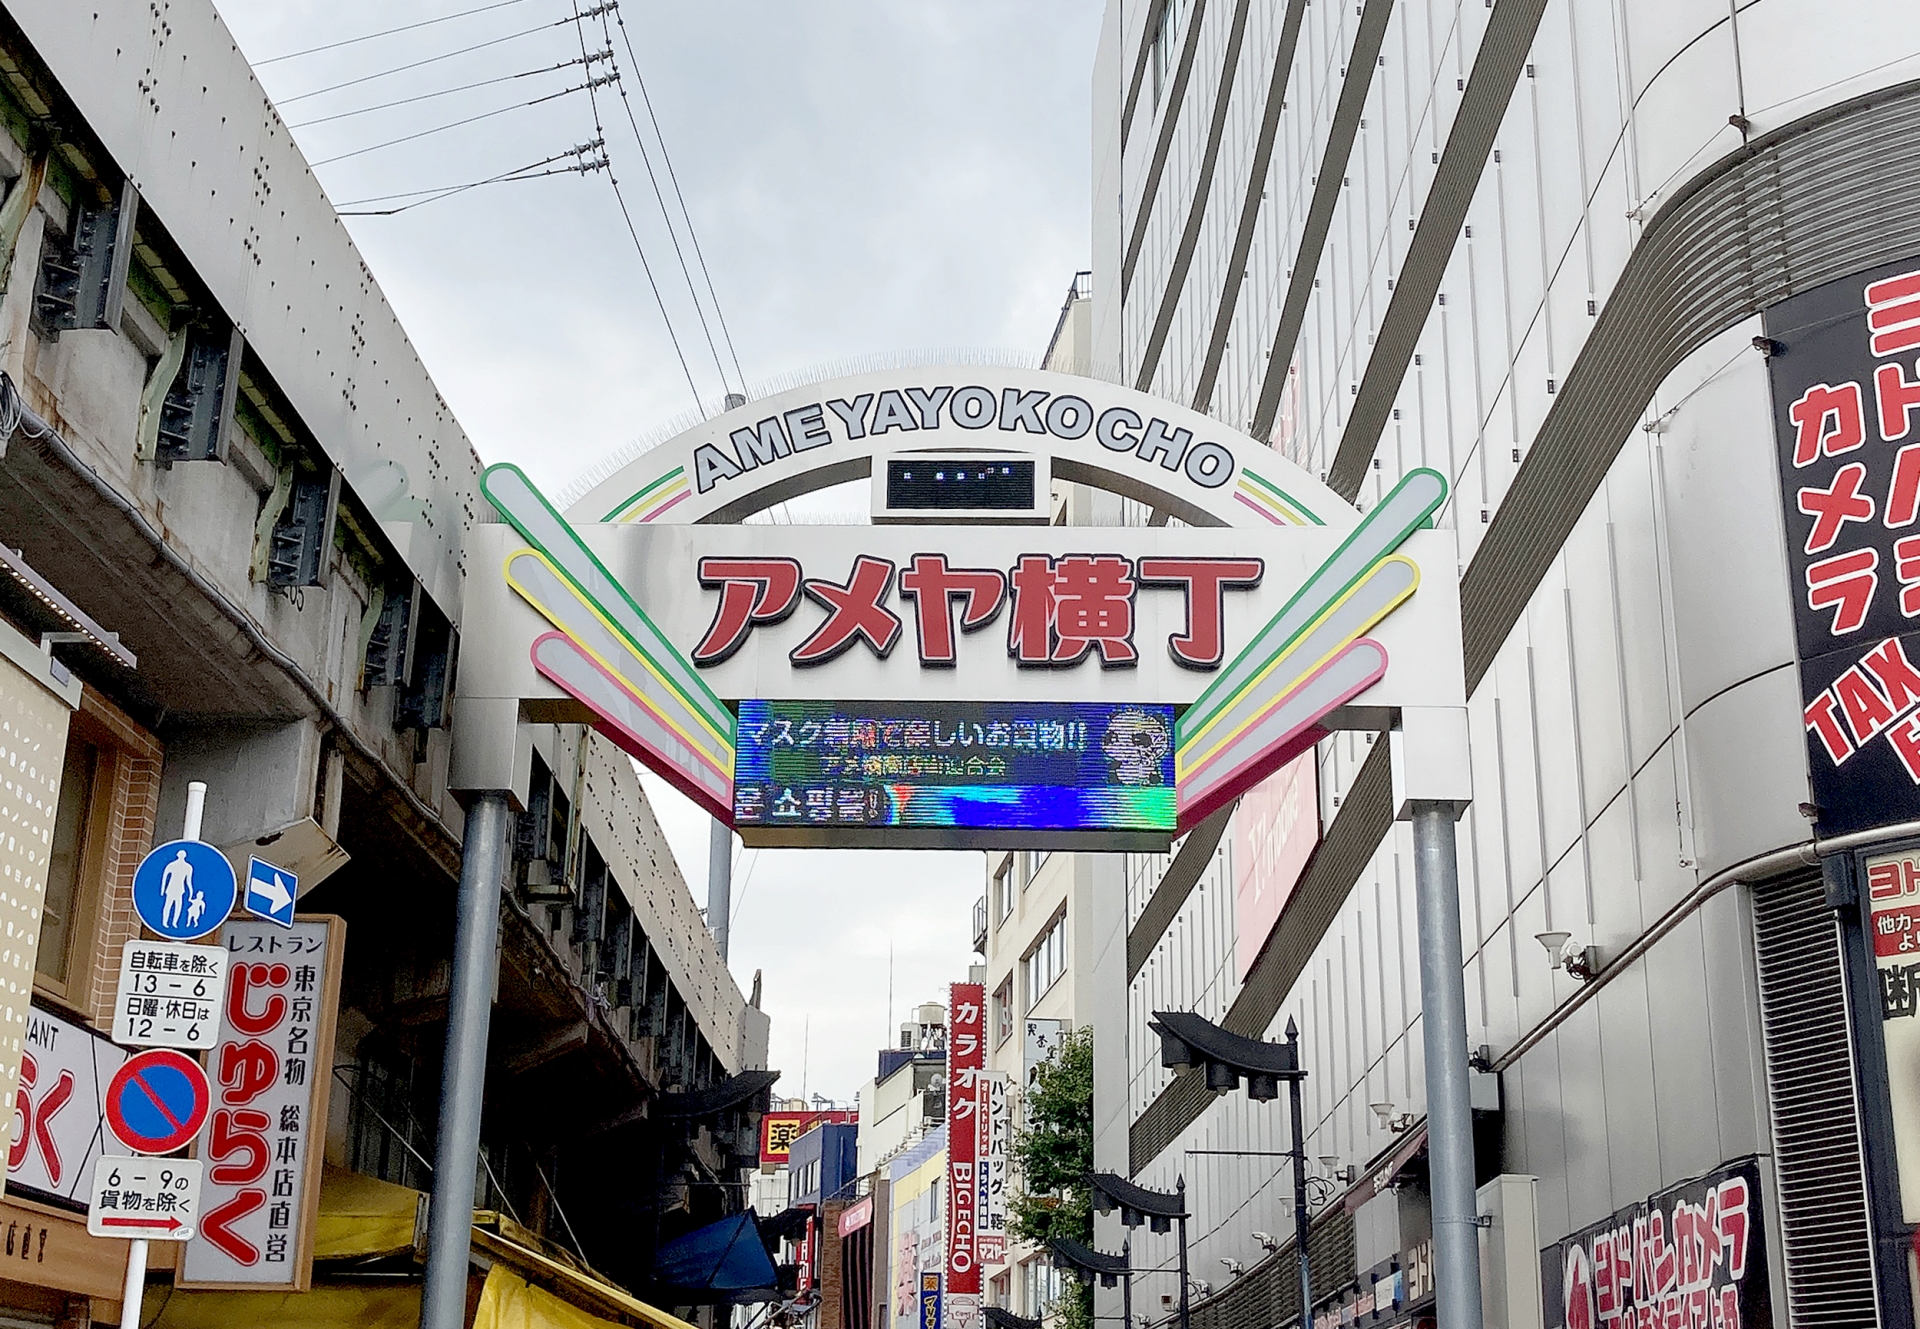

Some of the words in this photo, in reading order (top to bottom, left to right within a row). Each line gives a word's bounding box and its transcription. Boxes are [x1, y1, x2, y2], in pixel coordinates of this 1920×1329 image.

[694, 386, 1235, 494] AMEYAYOKOCHO
[1789, 381, 1879, 636] カメラ
[694, 553, 1264, 670] アメヤ横丁
[1804, 637, 1920, 767] TAX
[131, 950, 218, 975] 自転車を除く
[229, 935, 323, 954] レストラン
[127, 997, 210, 1020] 日曜・休日は
[284, 964, 316, 1086] 東京名物
[952, 1002, 979, 1120] カラオケ
[199, 961, 292, 1267] じゅらく
[99, 1189, 191, 1213] 貨物を除く
[265, 1104, 300, 1262] 総本店直営
[951, 1209, 973, 1273] ECHO
[952, 1162, 973, 1205] BIG
[1594, 1176, 1750, 1321] ヨドバシカメラ
